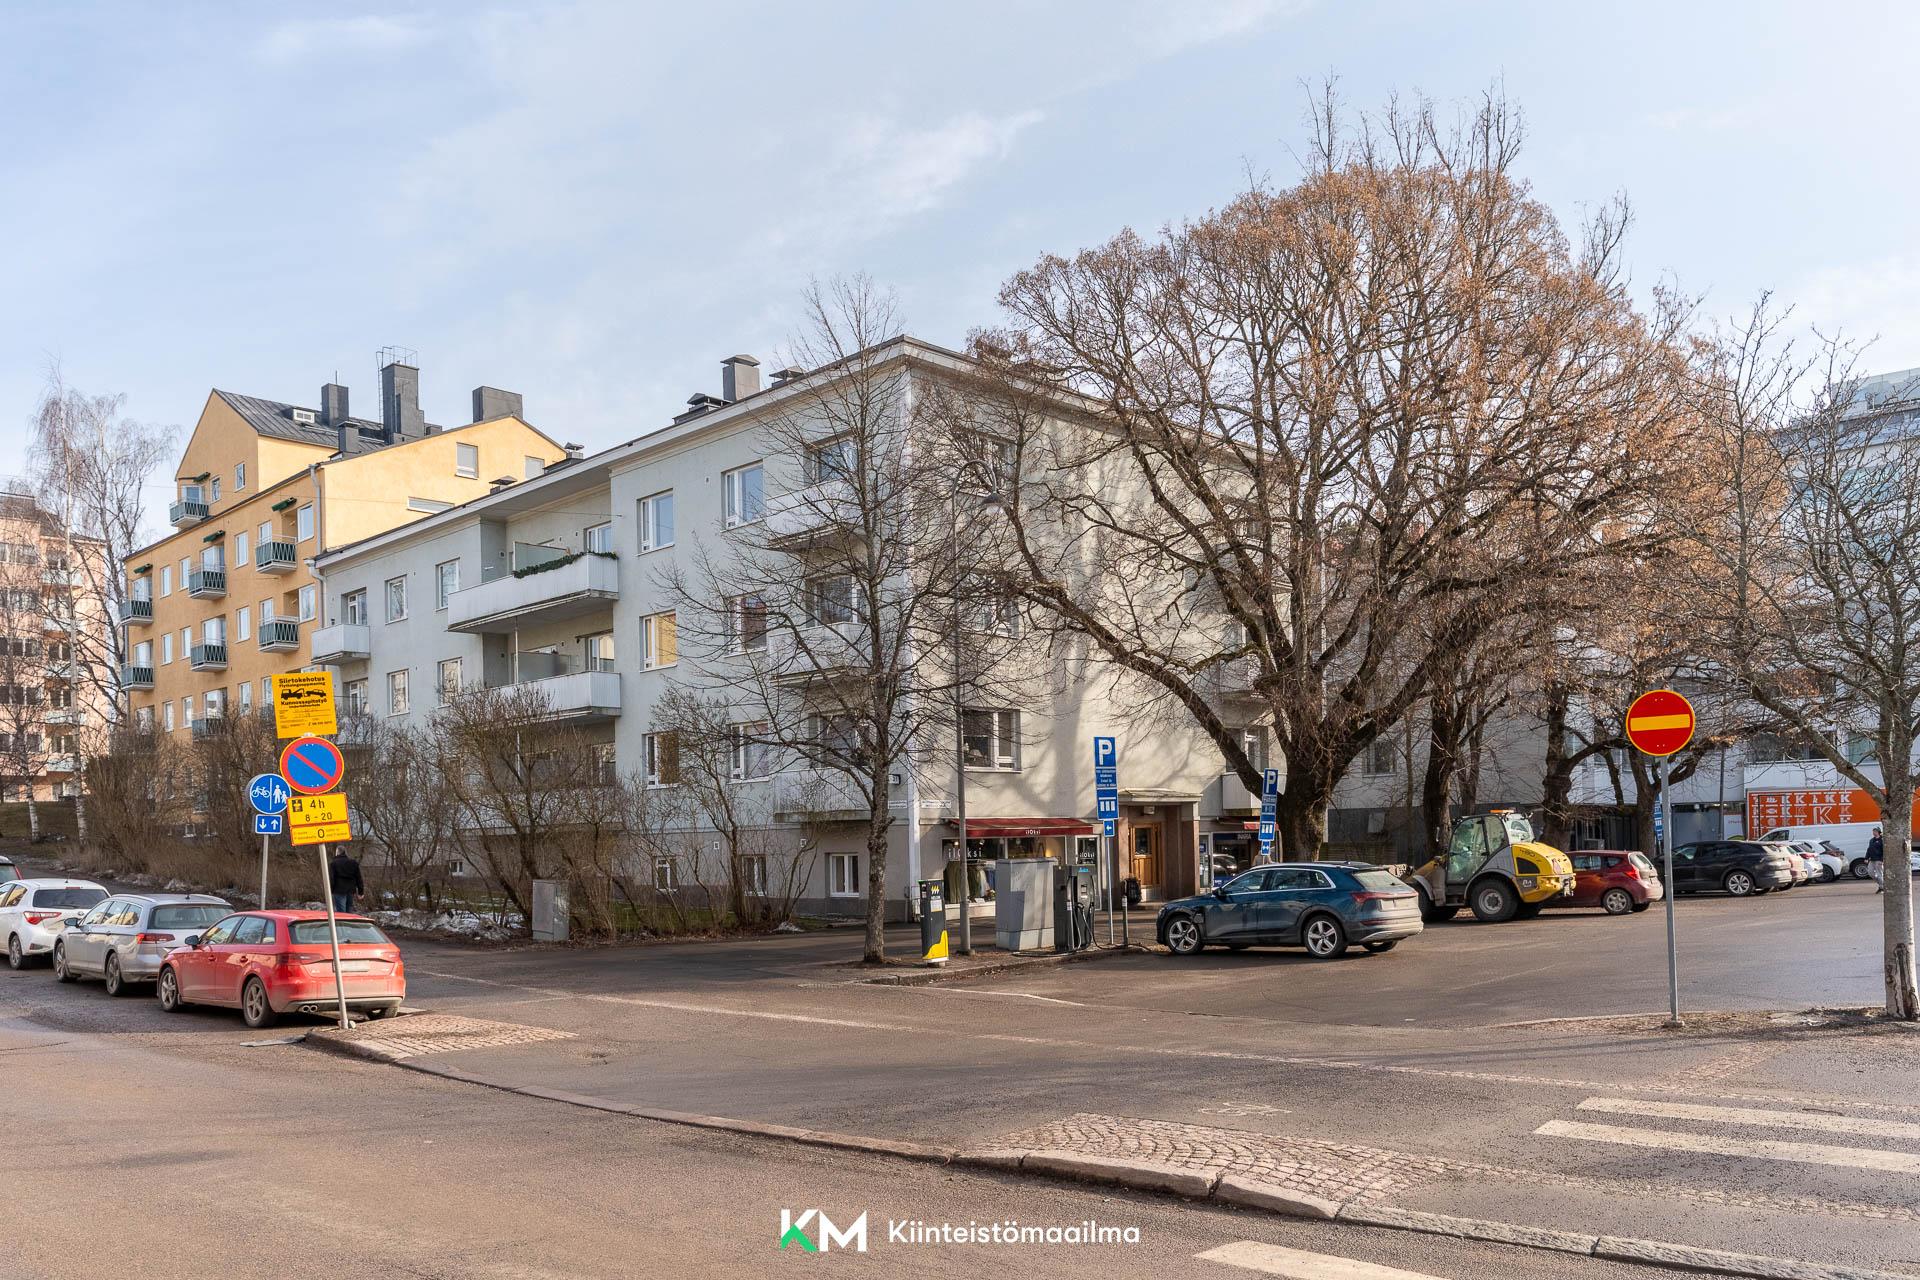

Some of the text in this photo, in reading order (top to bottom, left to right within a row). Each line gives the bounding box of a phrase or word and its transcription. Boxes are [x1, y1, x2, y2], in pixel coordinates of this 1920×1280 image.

[279, 676, 325, 684] Siirtokehotus
[1098, 739, 1112, 765] P
[1265, 770, 1276, 794] P
[310, 799, 325, 809] 4 h
[305, 813, 311, 822] 8
[320, 812, 332, 821] 20
